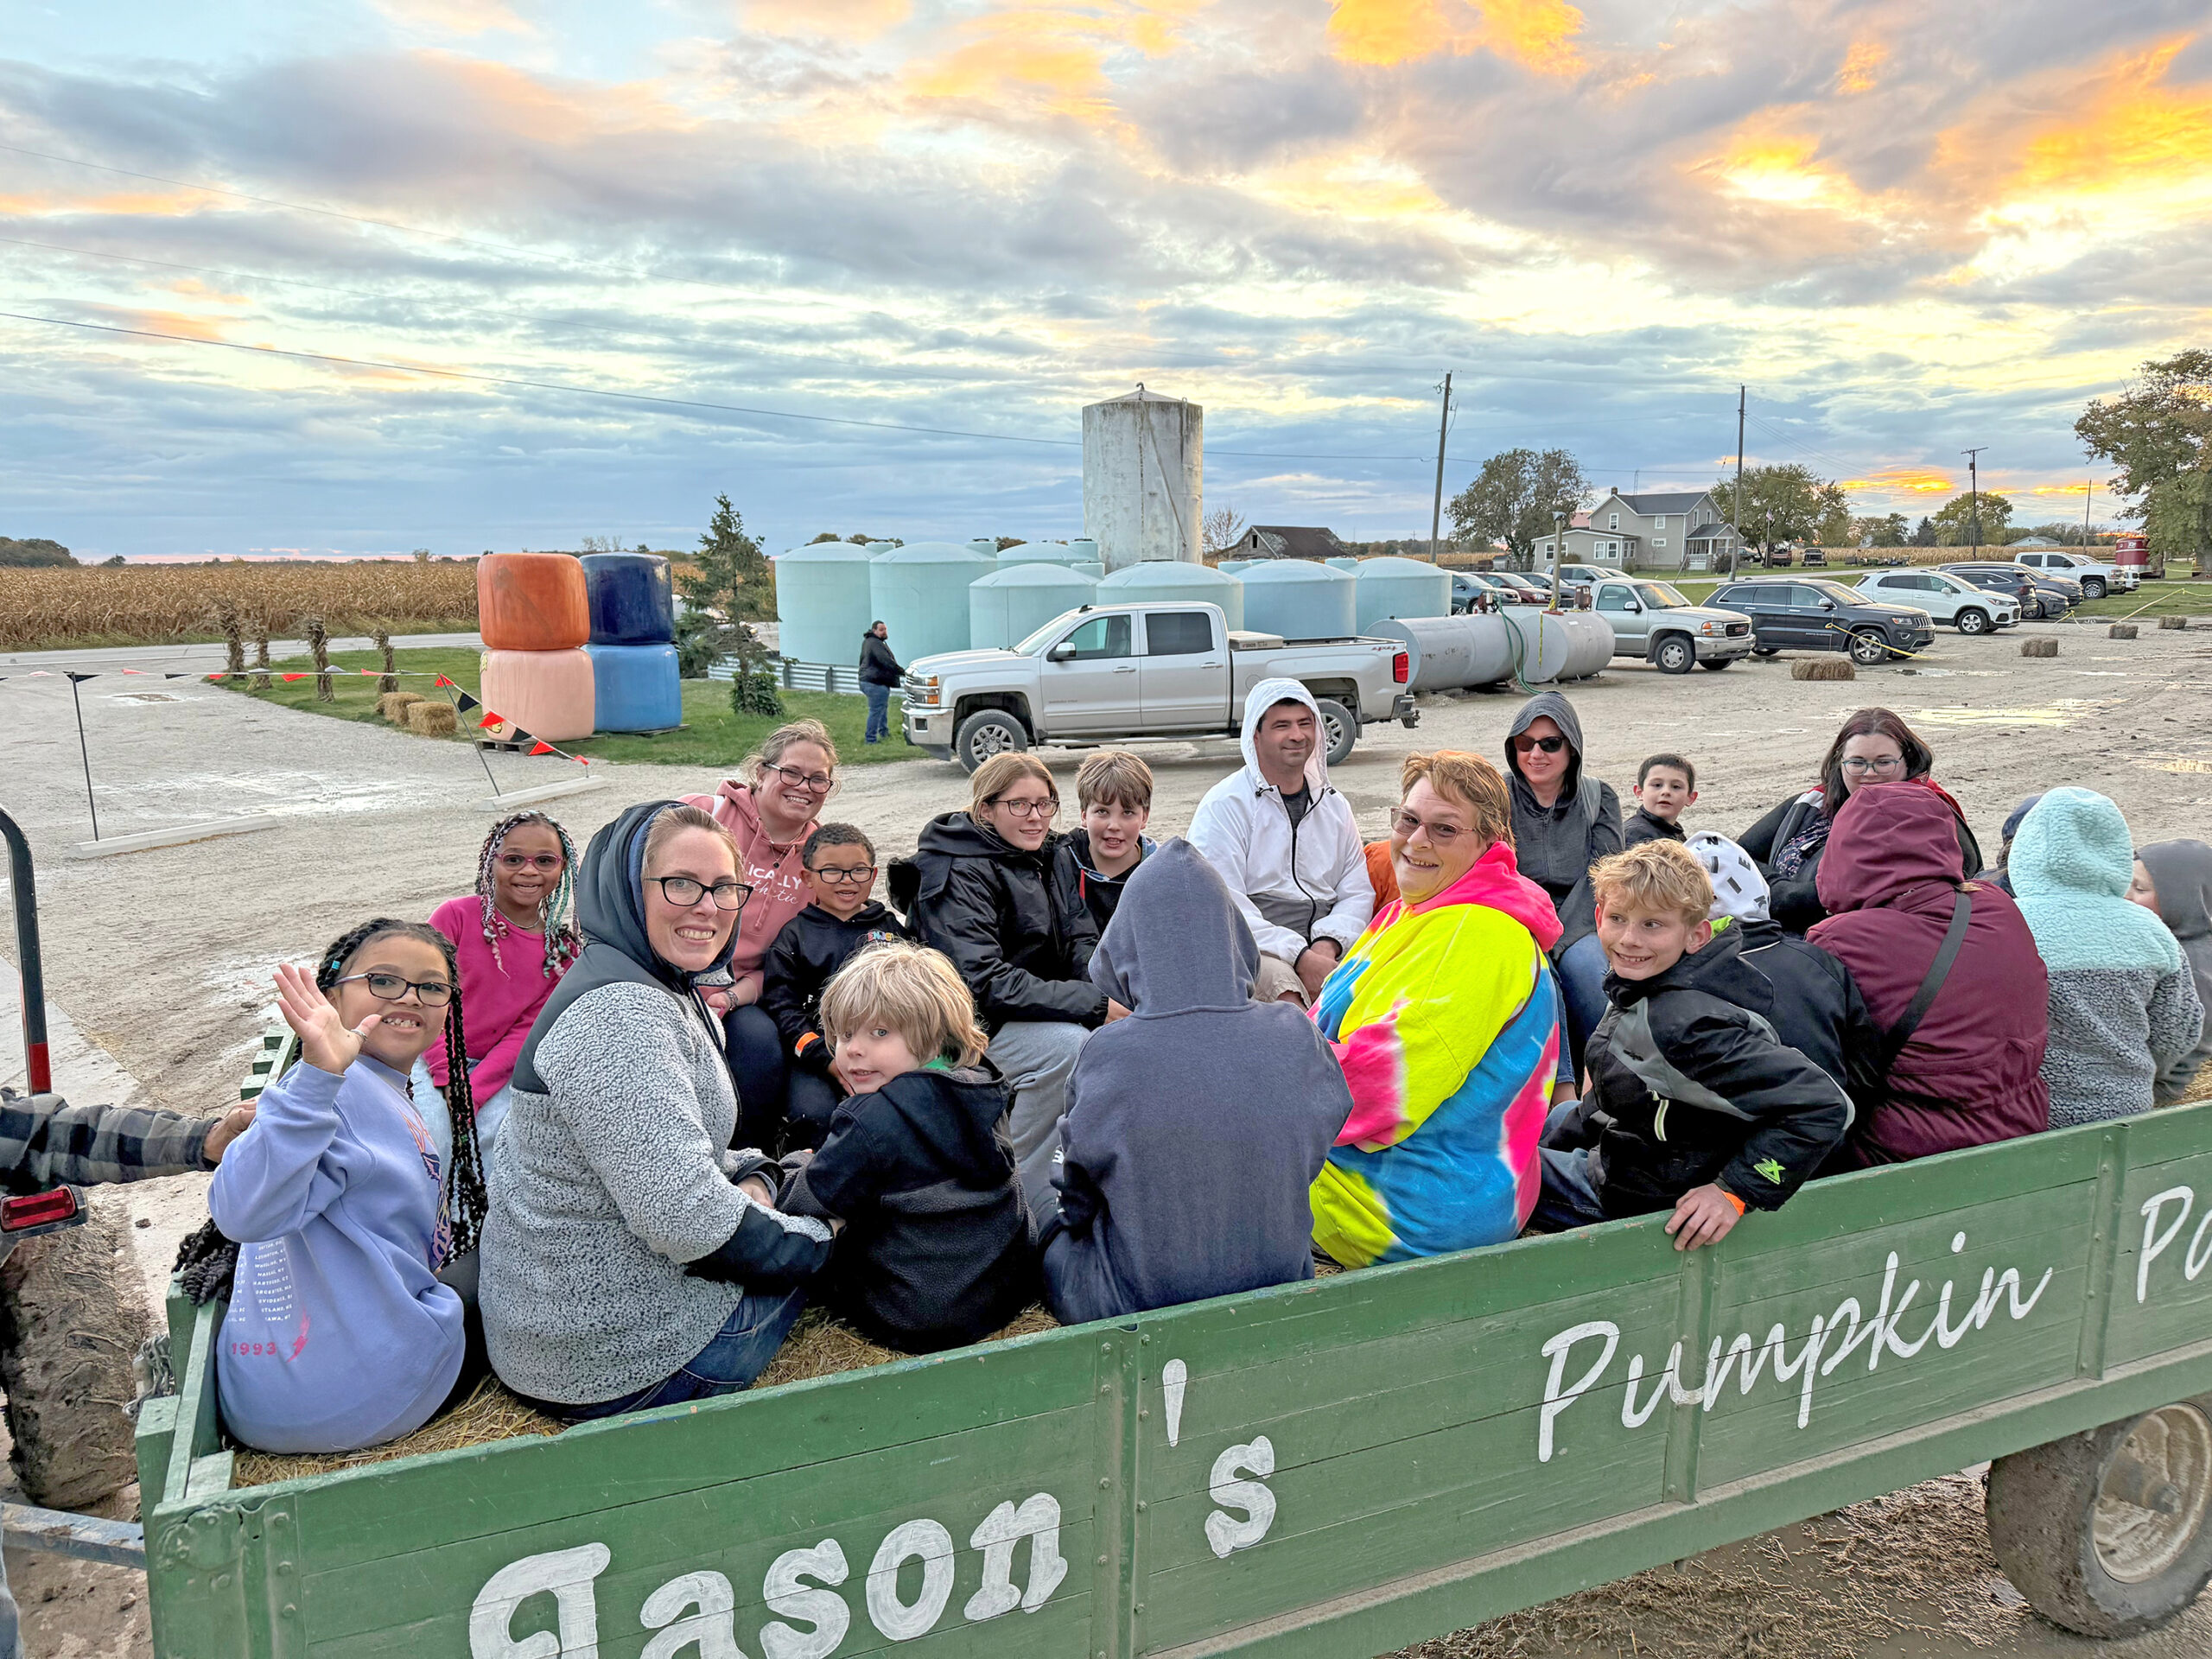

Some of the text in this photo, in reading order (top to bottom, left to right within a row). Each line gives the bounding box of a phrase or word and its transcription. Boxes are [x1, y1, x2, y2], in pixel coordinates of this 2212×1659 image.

[747, 862, 803, 890] ICALY
[231, 1341, 277, 1356] 1993
[1538, 1231, 2054, 1463] Pumpkin
